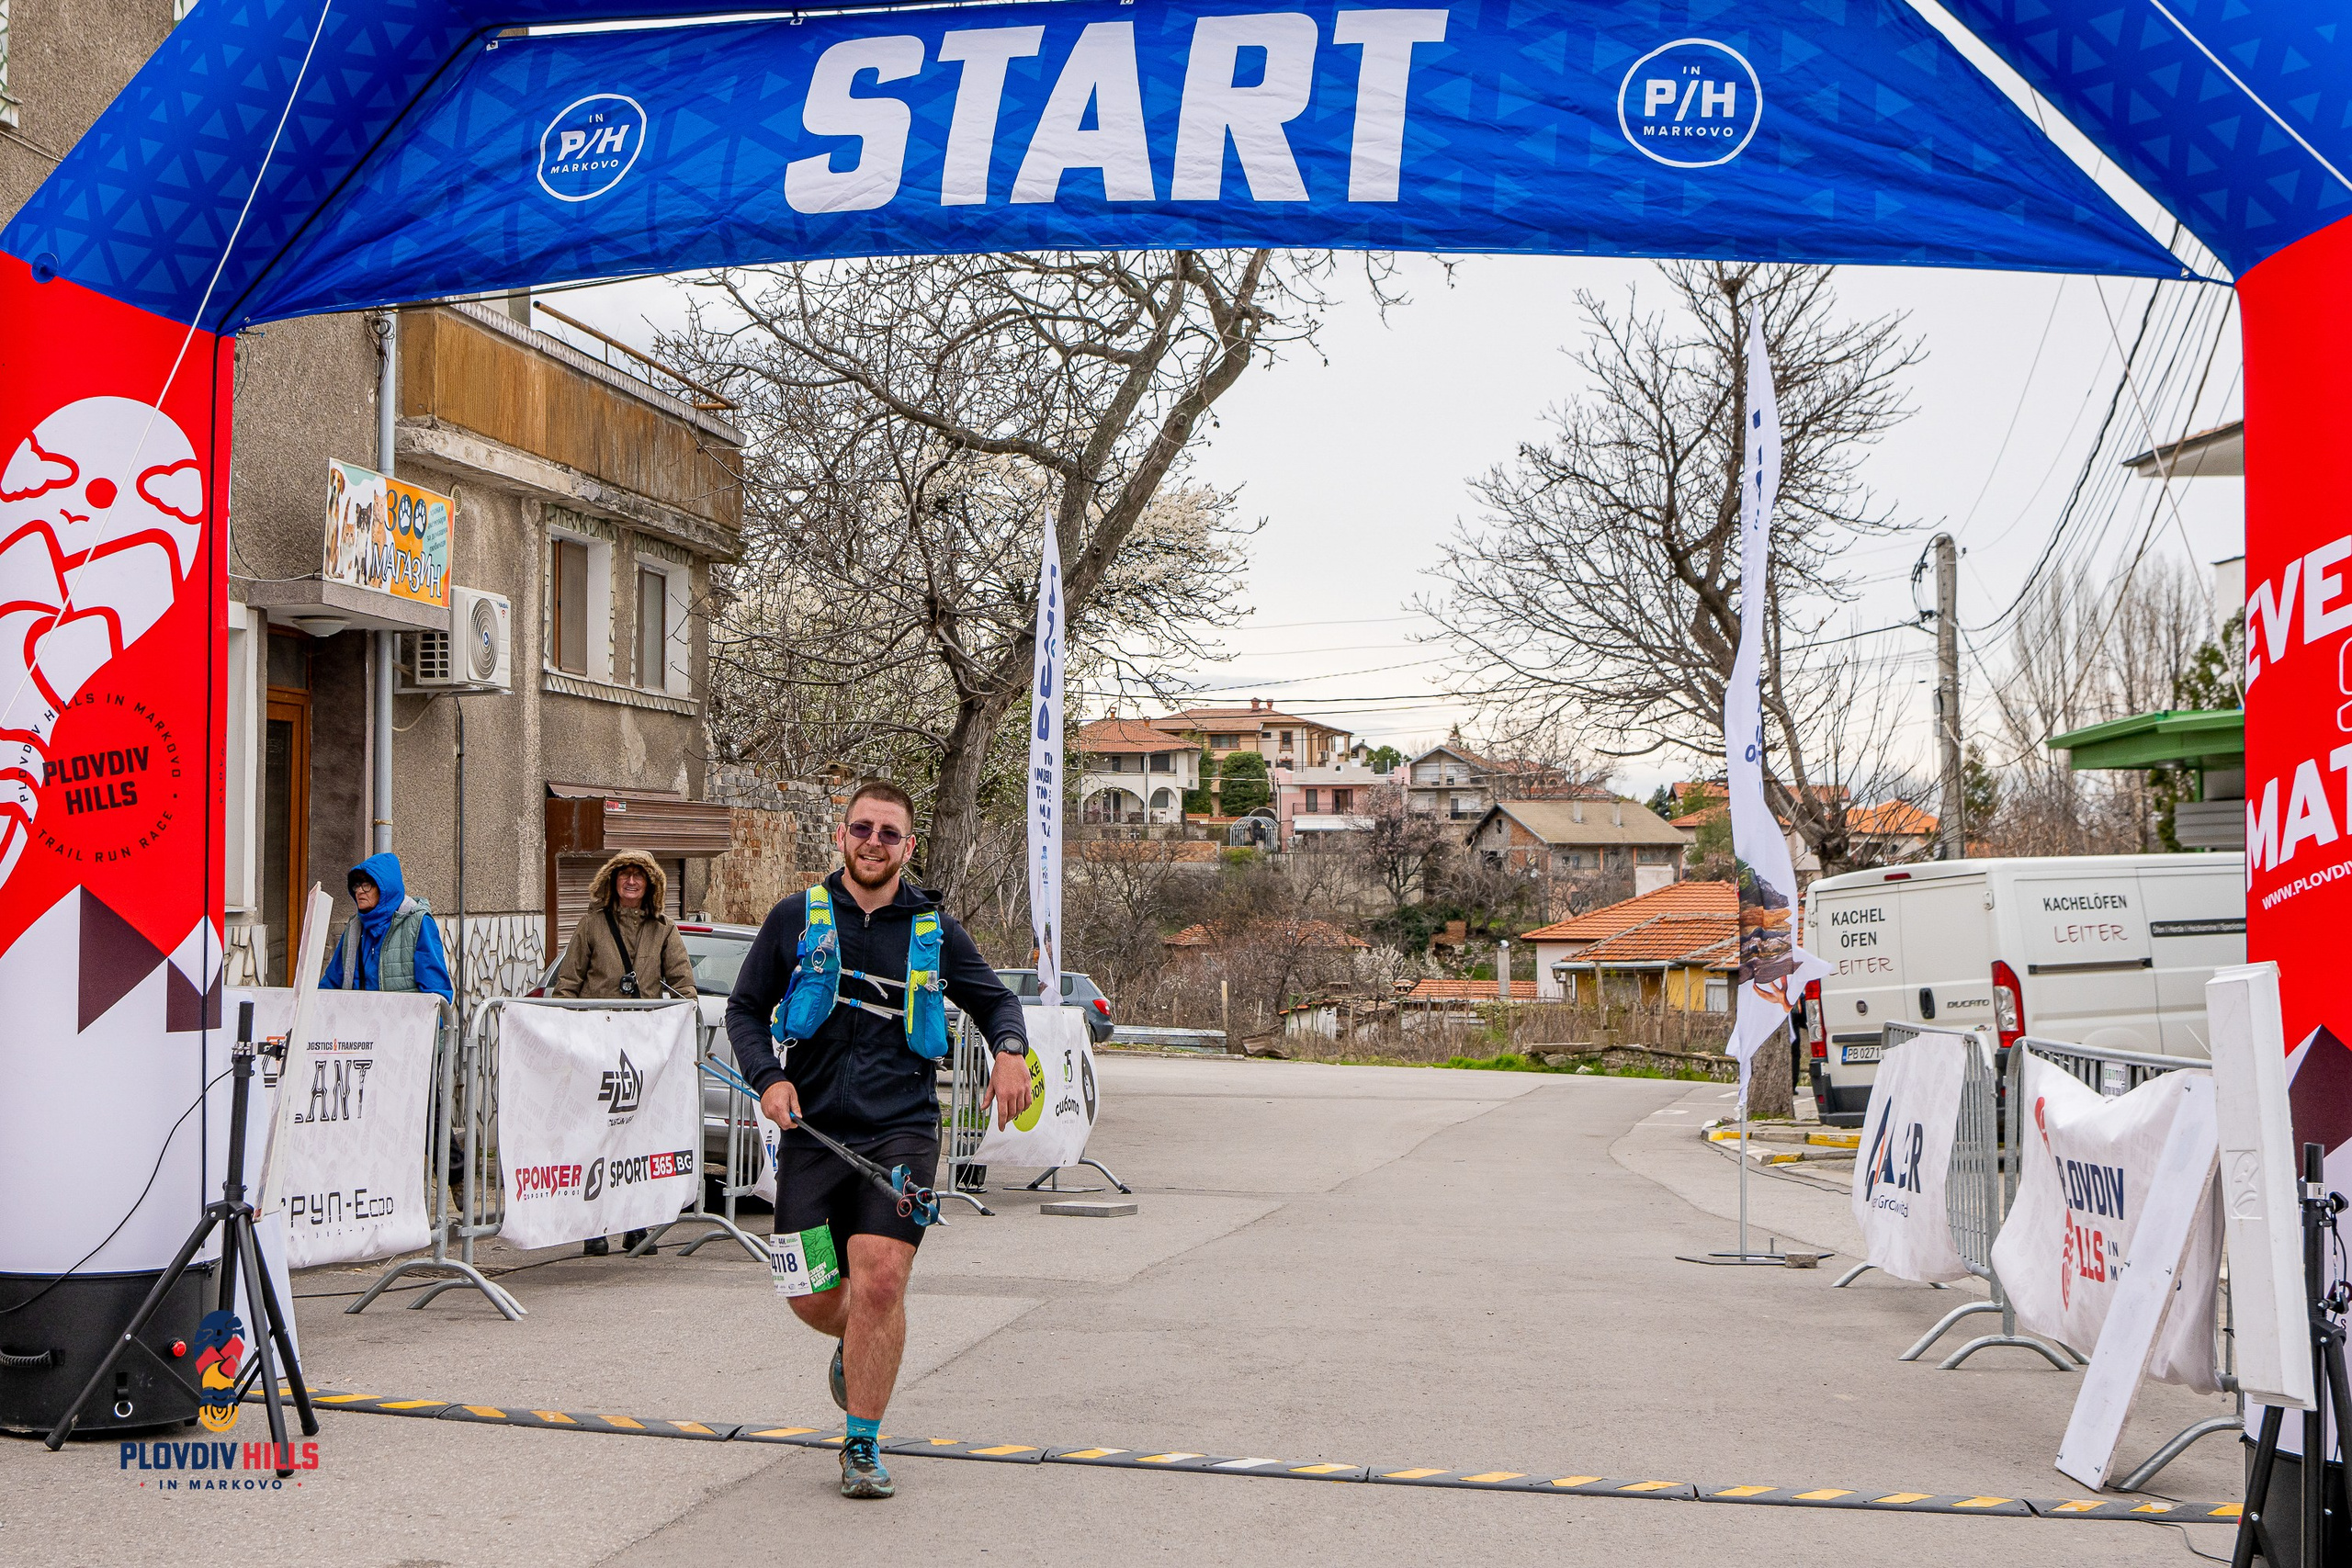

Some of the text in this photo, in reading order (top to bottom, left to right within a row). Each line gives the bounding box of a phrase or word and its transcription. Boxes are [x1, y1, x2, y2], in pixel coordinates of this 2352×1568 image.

[1682, 65, 1701, 75] IN
[1644, 79, 1736, 122] P/H
[589, 113, 604, 123] IN
[785, 8, 1449, 214] START
[1643, 126, 1734, 138] MARKOVO
[557, 124, 630, 162] P/H
[550, 159, 619, 175] MARKOVO
[371, 542, 442, 598] МАГАЗИН
[18, 724, 41, 803] PLOVDIV
[44, 693, 95, 722] HILLS
[107, 693, 125, 706] IN
[134, 702, 181, 778] MARKOVO
[42, 746, 150, 787] PLOVDIV
[65, 781, 139, 816] HILLS
[38, 810, 173, 863] TRAIL RUN RACE
[2042, 892, 2128, 912] KACHELÖFEN
[1831, 908, 1886, 926] KACHEL
[1840, 930, 1878, 948] ÖFEN
[2054, 923, 2129, 943] LEITER
[1947, 998, 1990, 1010] DUCATO
[338, 1041, 374, 1051] TRANSPORT
[1860, 1047, 1880, 1059] 0271
[515, 1165, 582, 1202] SPONSER
[2107, 1240, 2119, 1258] IN
